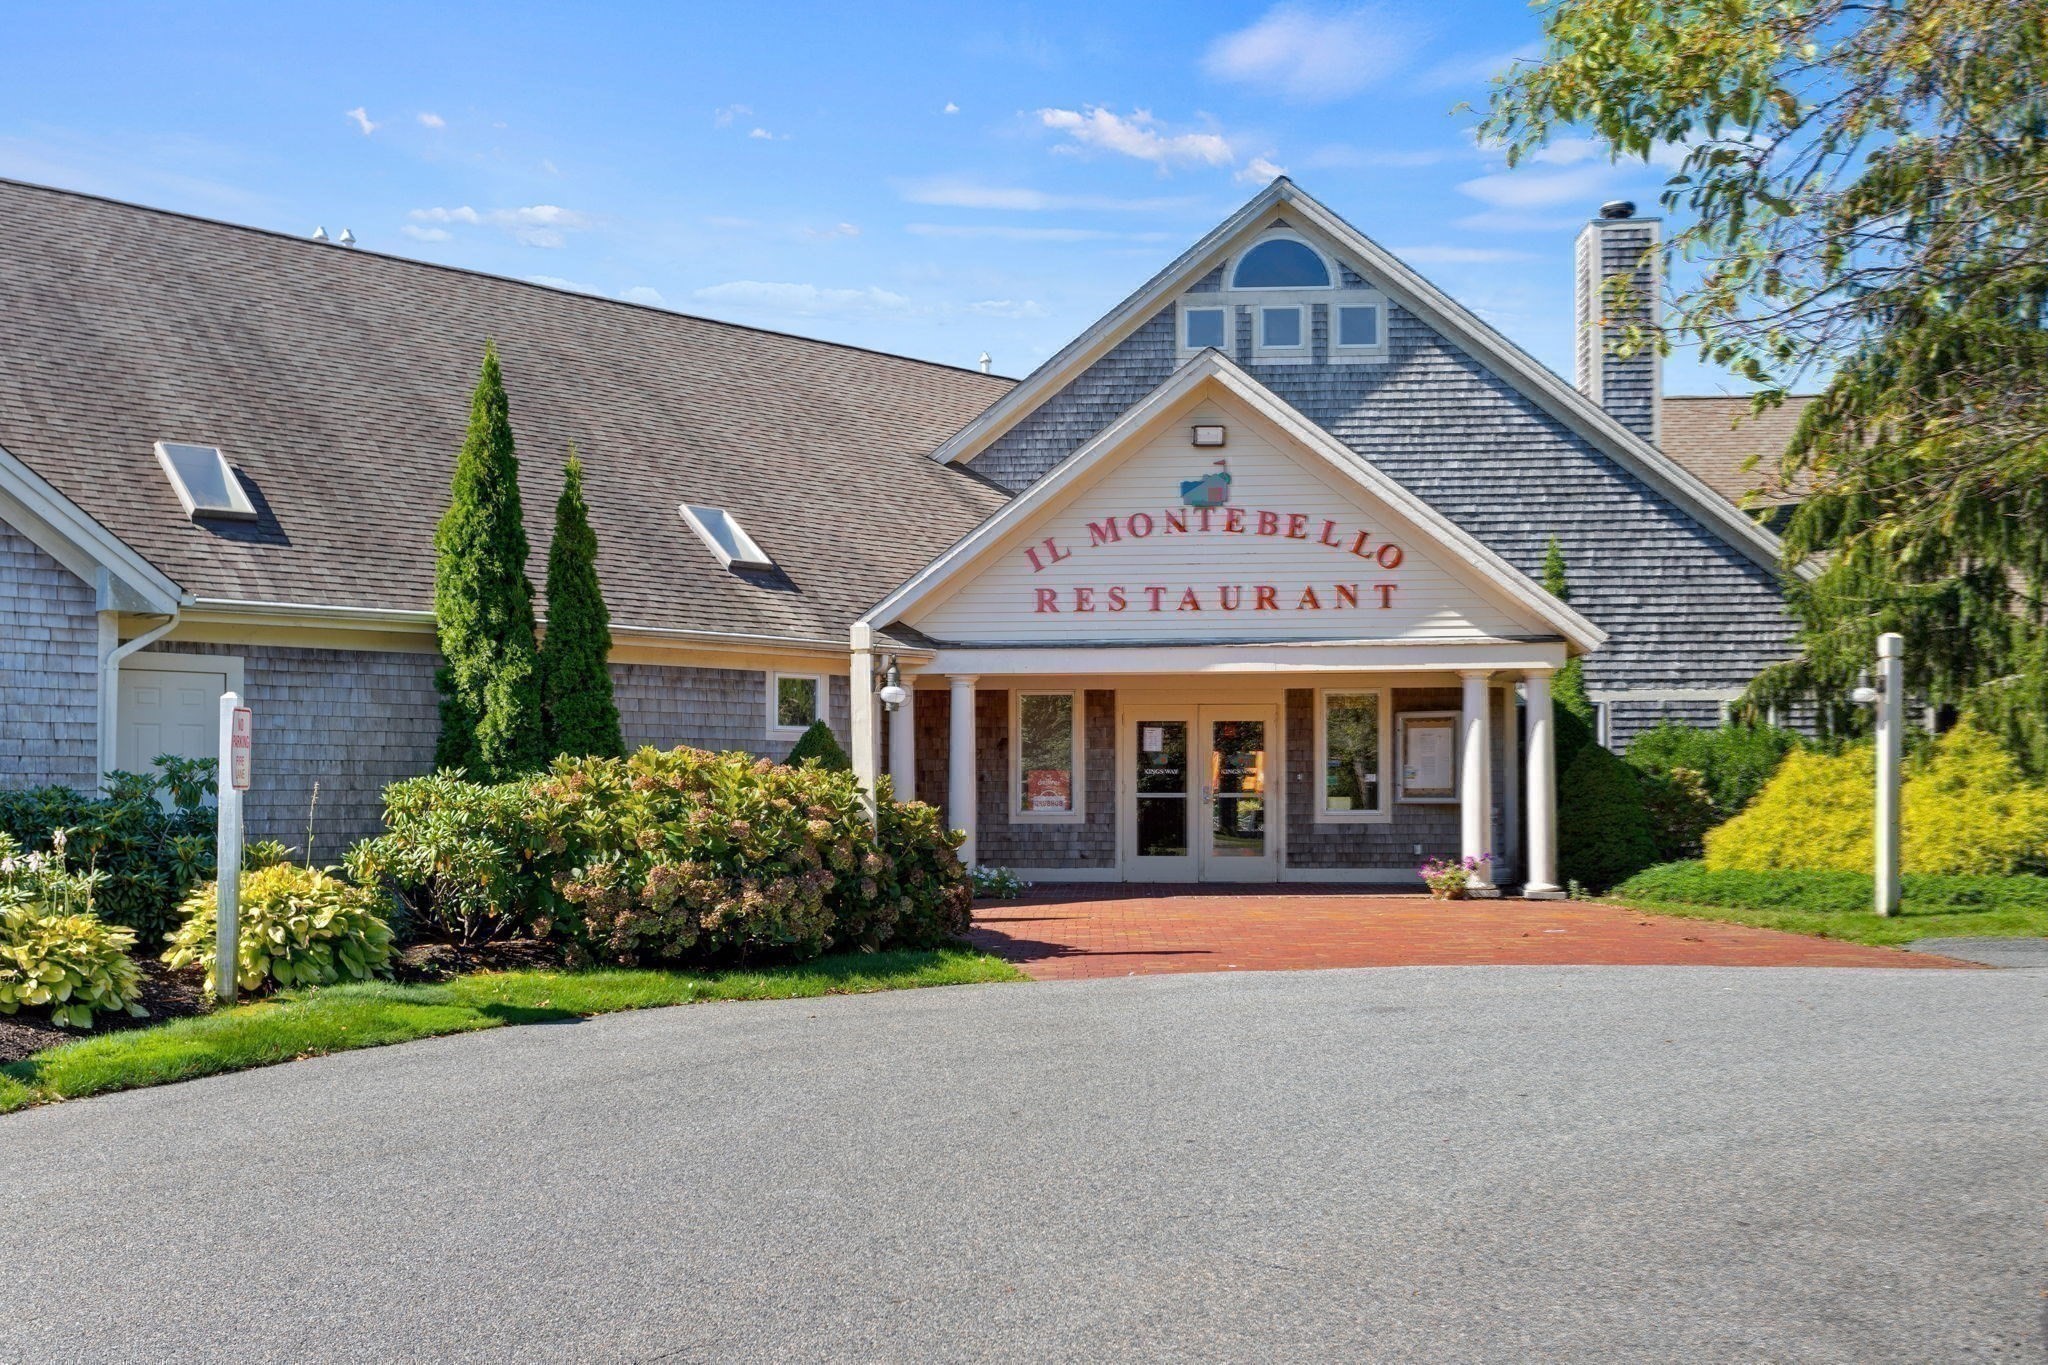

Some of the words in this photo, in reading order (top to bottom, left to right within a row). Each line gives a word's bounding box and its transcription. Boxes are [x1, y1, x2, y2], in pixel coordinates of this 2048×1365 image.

[1024, 537, 1071, 573] IL
[1086, 506, 1403, 569] MONTEBELLO
[1034, 584, 1397, 613] RESTAURANT
